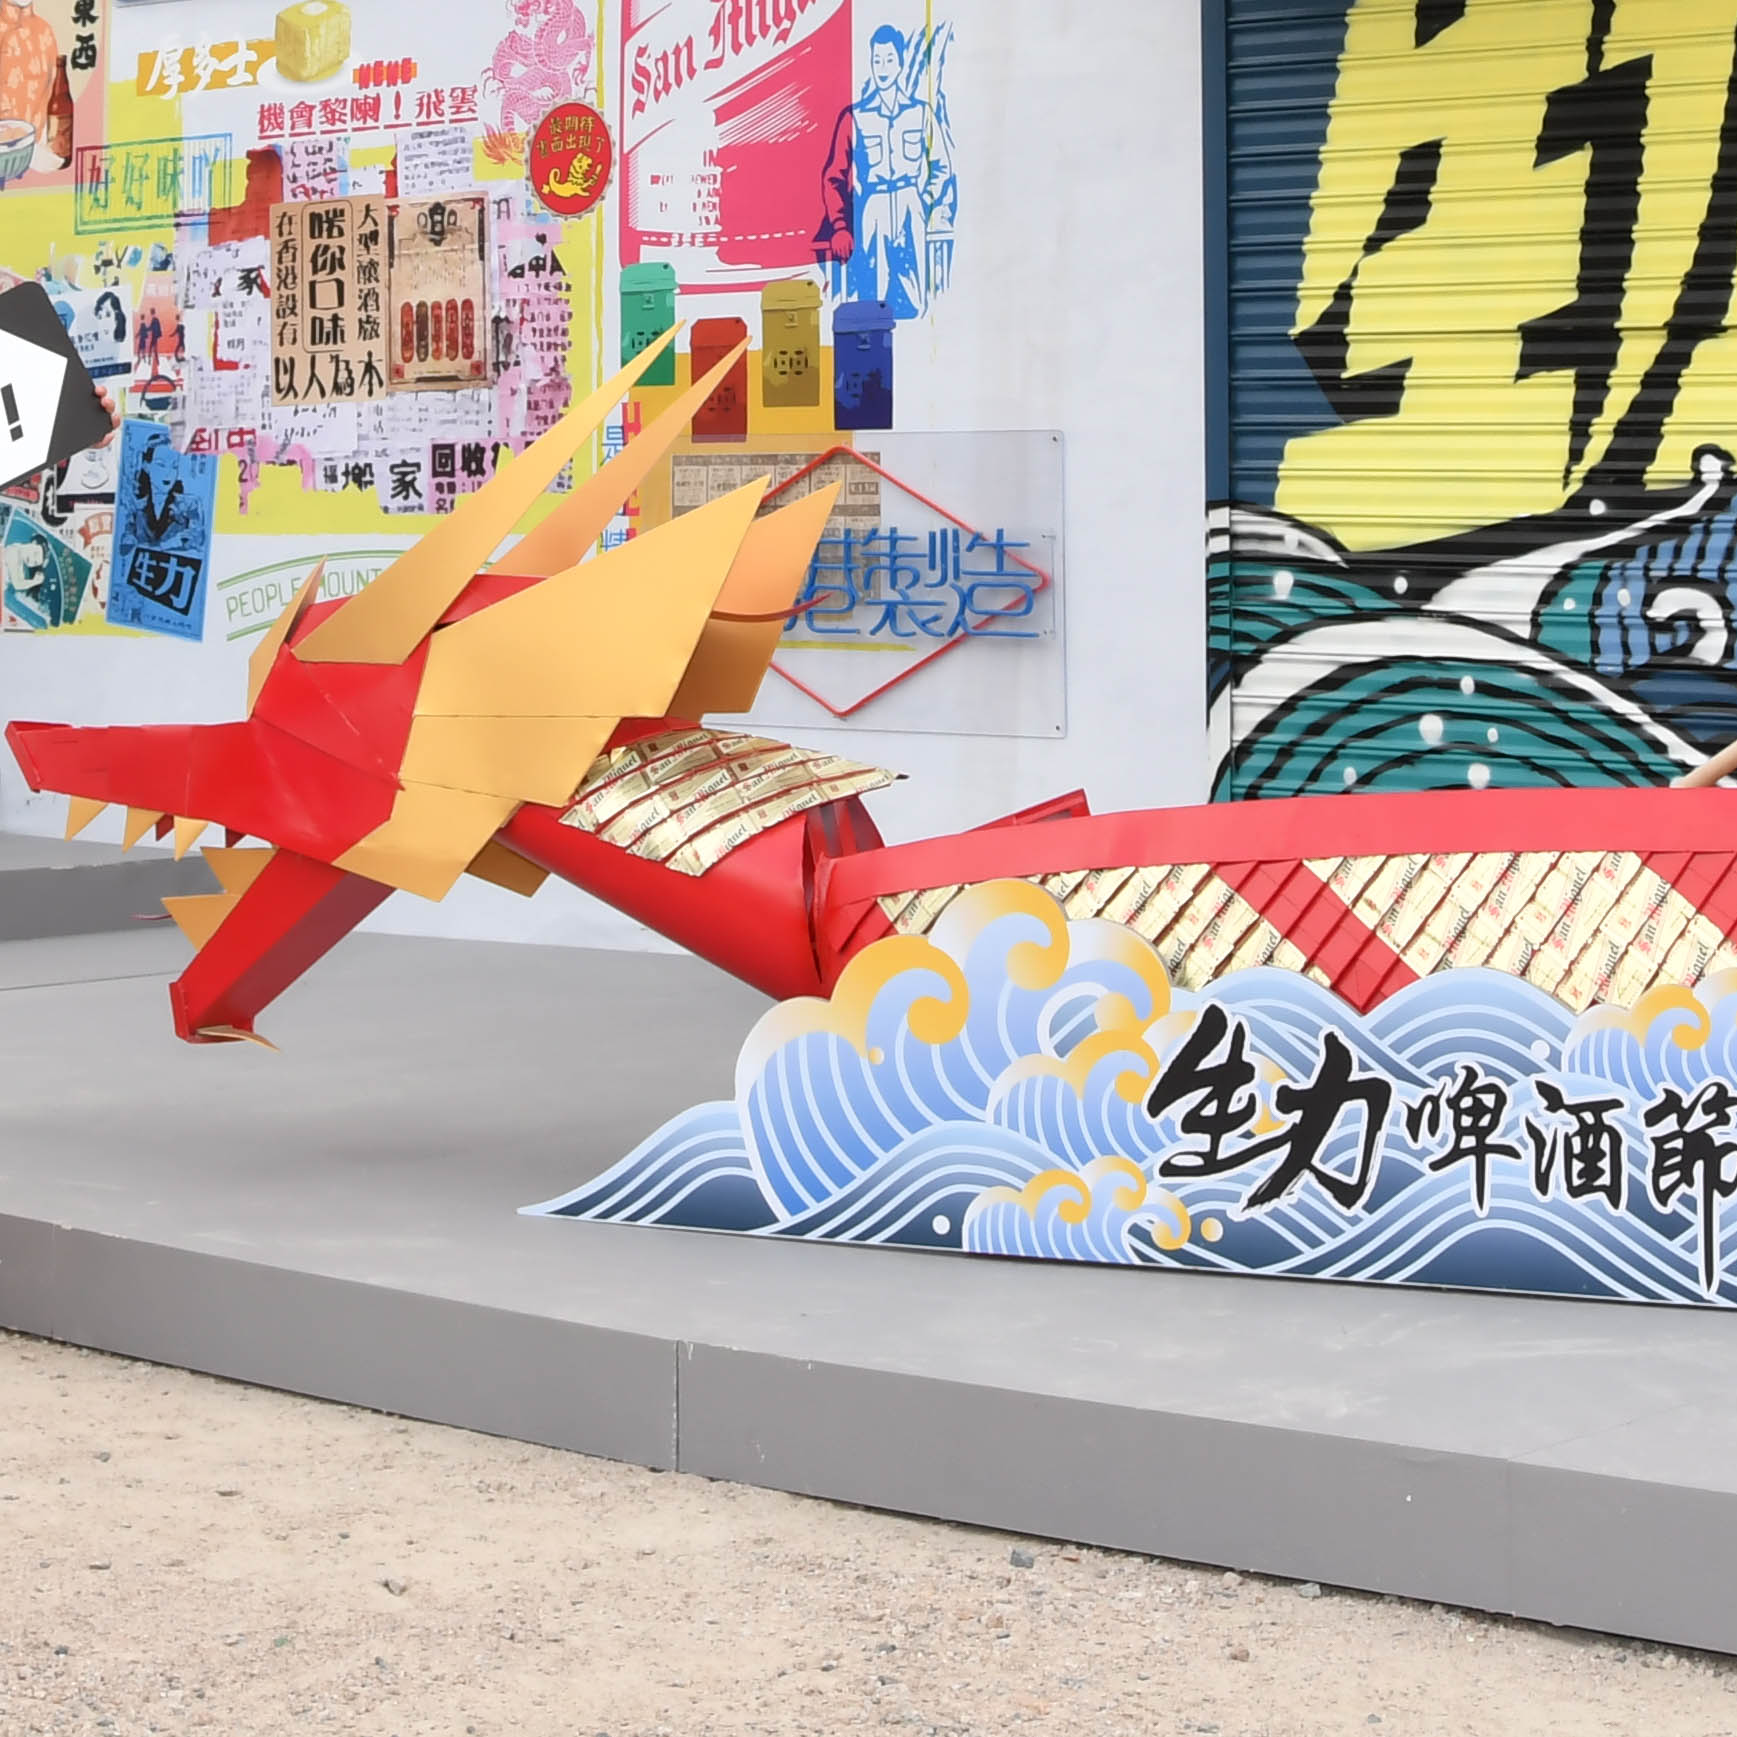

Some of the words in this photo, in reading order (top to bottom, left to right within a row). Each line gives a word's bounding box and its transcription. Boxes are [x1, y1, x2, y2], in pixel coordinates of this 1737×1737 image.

[631, 30, 696, 119] San
[274, 349, 385, 401] 以人為本
[131, 551, 197, 609] 生力
